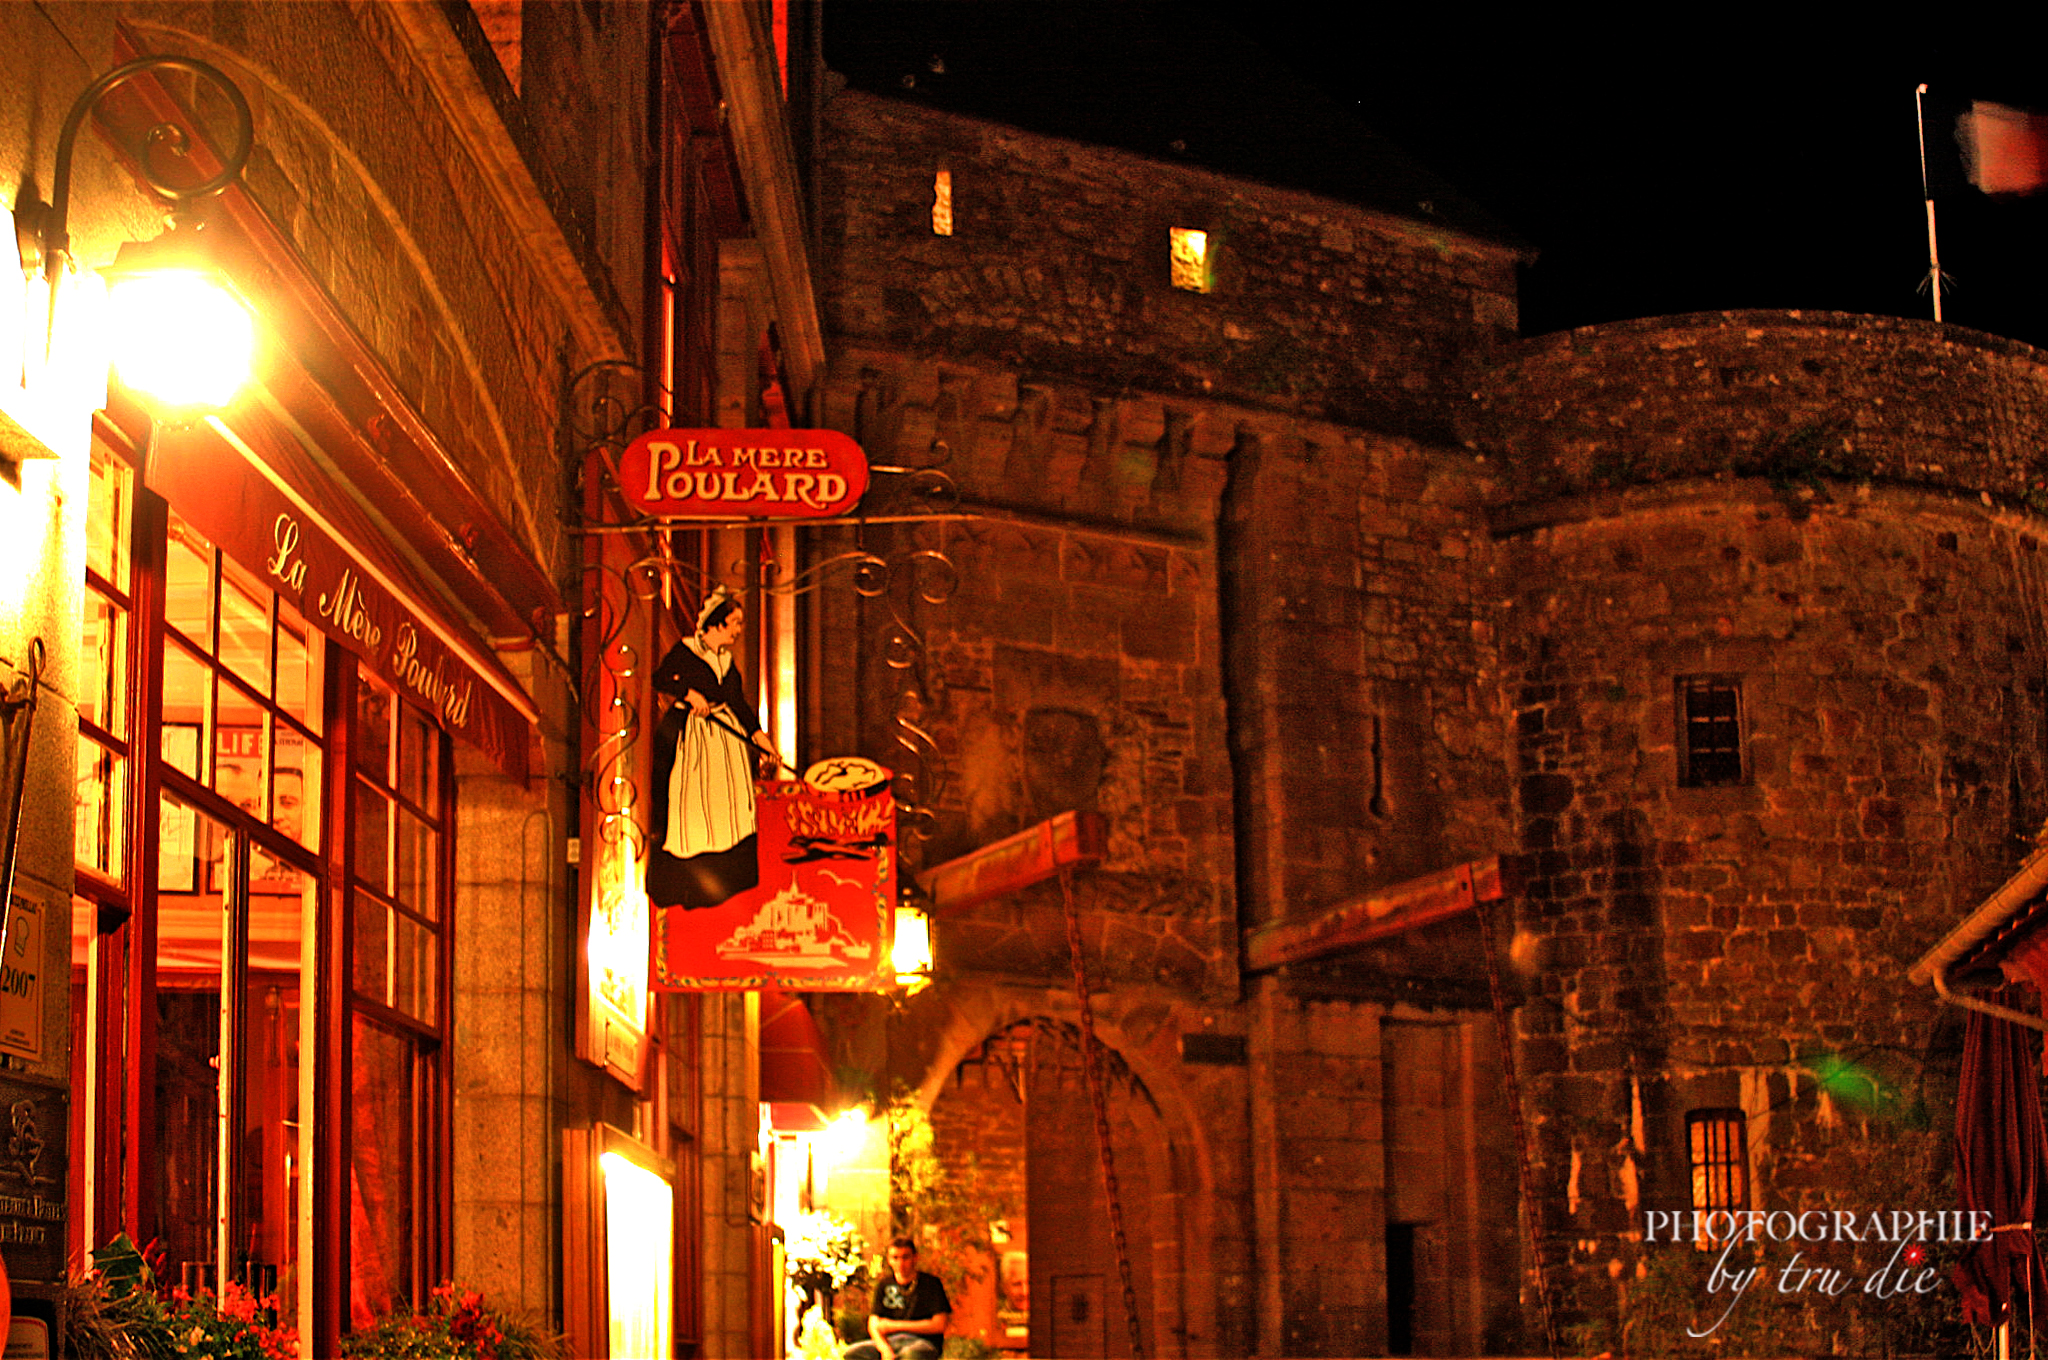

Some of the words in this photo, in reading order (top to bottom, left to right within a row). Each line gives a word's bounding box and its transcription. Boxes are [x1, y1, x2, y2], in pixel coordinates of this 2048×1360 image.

[643, 442, 848, 510] POULARD
[686, 439, 720, 467] LA
[733, 447, 829, 472] MERE
[267, 513, 307, 595] La
[318, 568, 381, 650] Mère
[1, 964, 36, 1001] 2007
